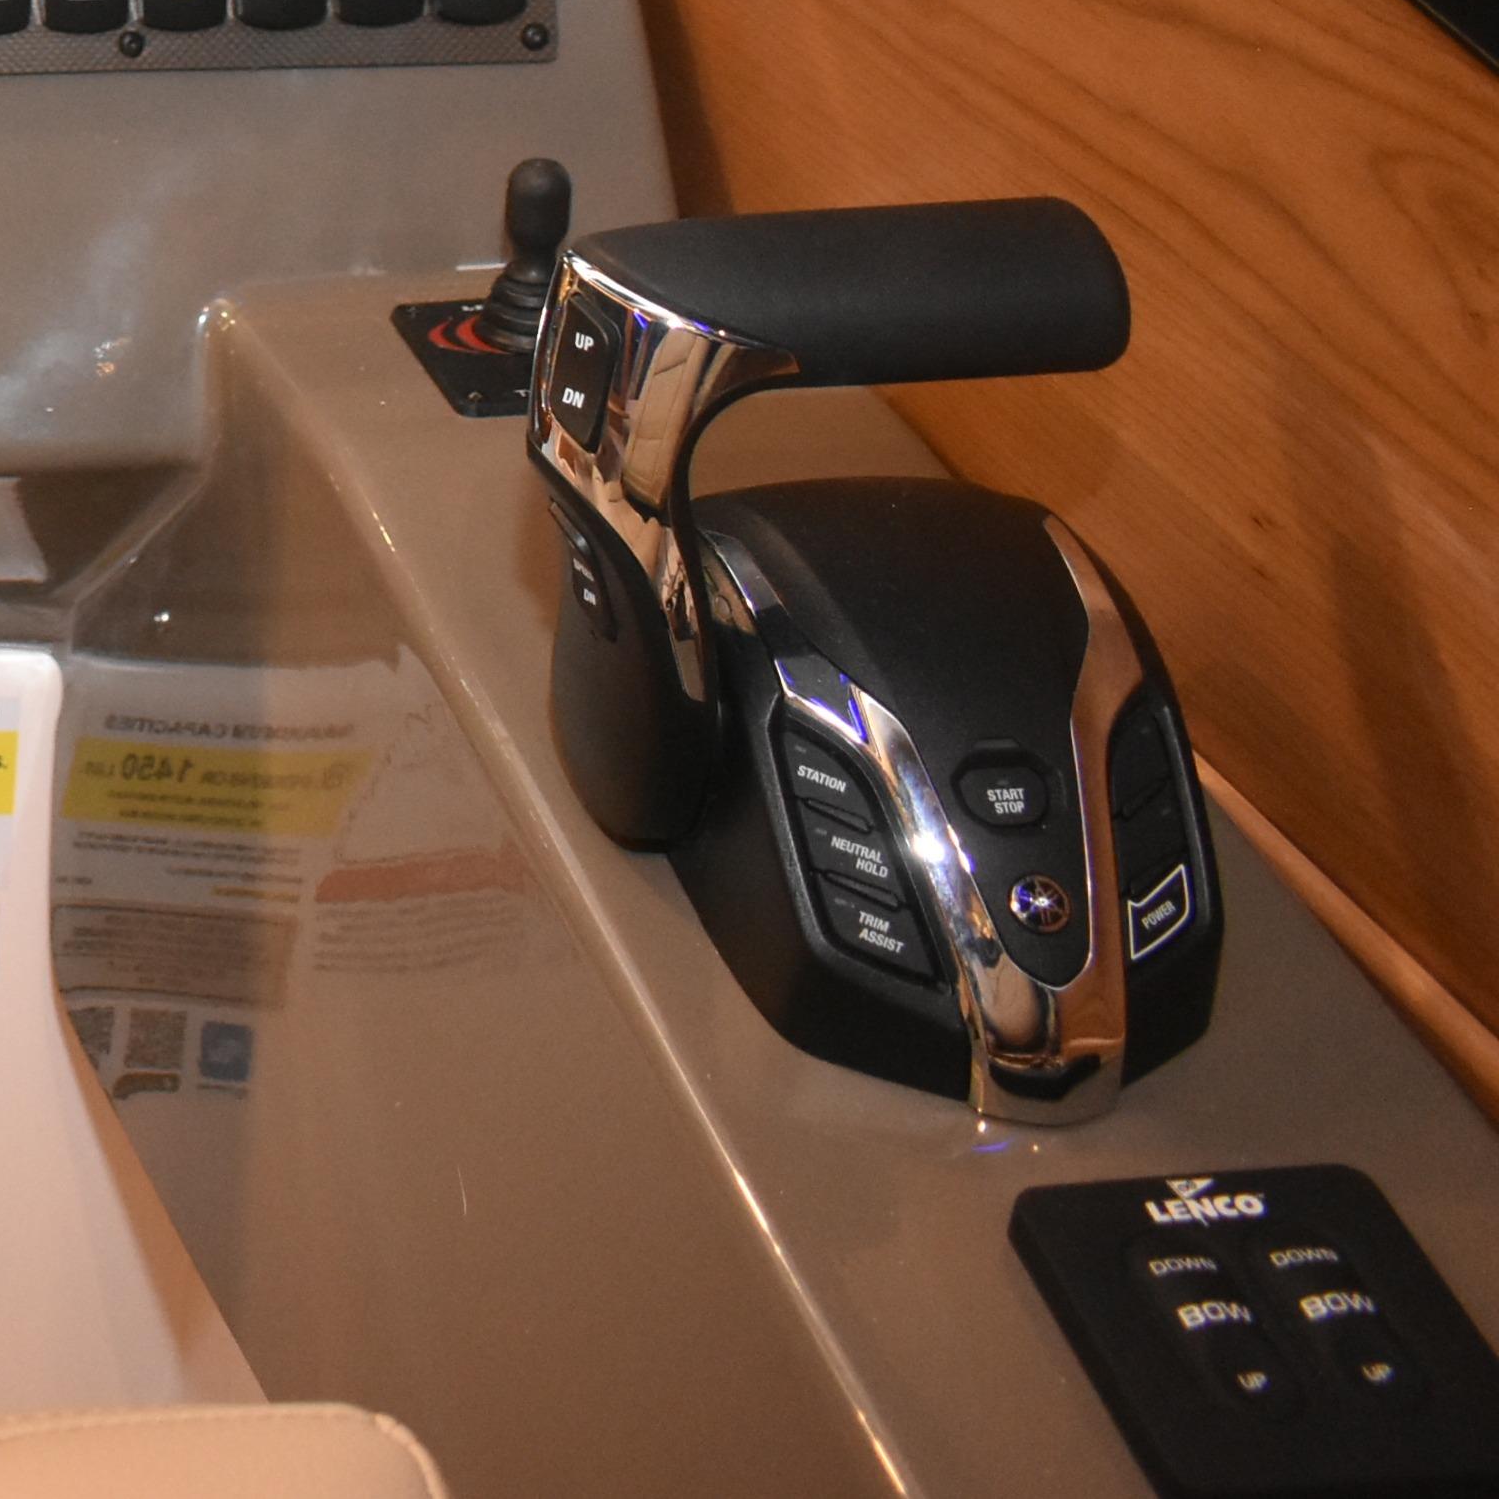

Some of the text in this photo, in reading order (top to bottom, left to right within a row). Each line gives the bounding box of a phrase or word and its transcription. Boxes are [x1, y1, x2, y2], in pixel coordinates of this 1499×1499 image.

[574, 332, 595, 351] UP
[562, 387, 585, 408] DN
[797, 764, 847, 793] STATION
[987, 788, 1025, 802] START
[994, 801, 1025, 814] STOP
[831, 836, 884, 863] NEUTRAL
[856, 857, 889, 879] HOLD
[859, 910, 889, 933] TRIM
[1141, 900, 1177, 930] POWER
[859, 928, 905, 954] ASSIST
[1145, 1194, 1265, 1226] LENCO
[1149, 1254, 1218, 1278] DOWN
[1270, 1246, 1339, 1269] DOWN
[1177, 1301, 1252, 1330] BOW
[1300, 1291, 1376, 1322] BOW
[1237, 1371, 1269, 1391] UP
[1362, 1362, 1394, 1382] UP
